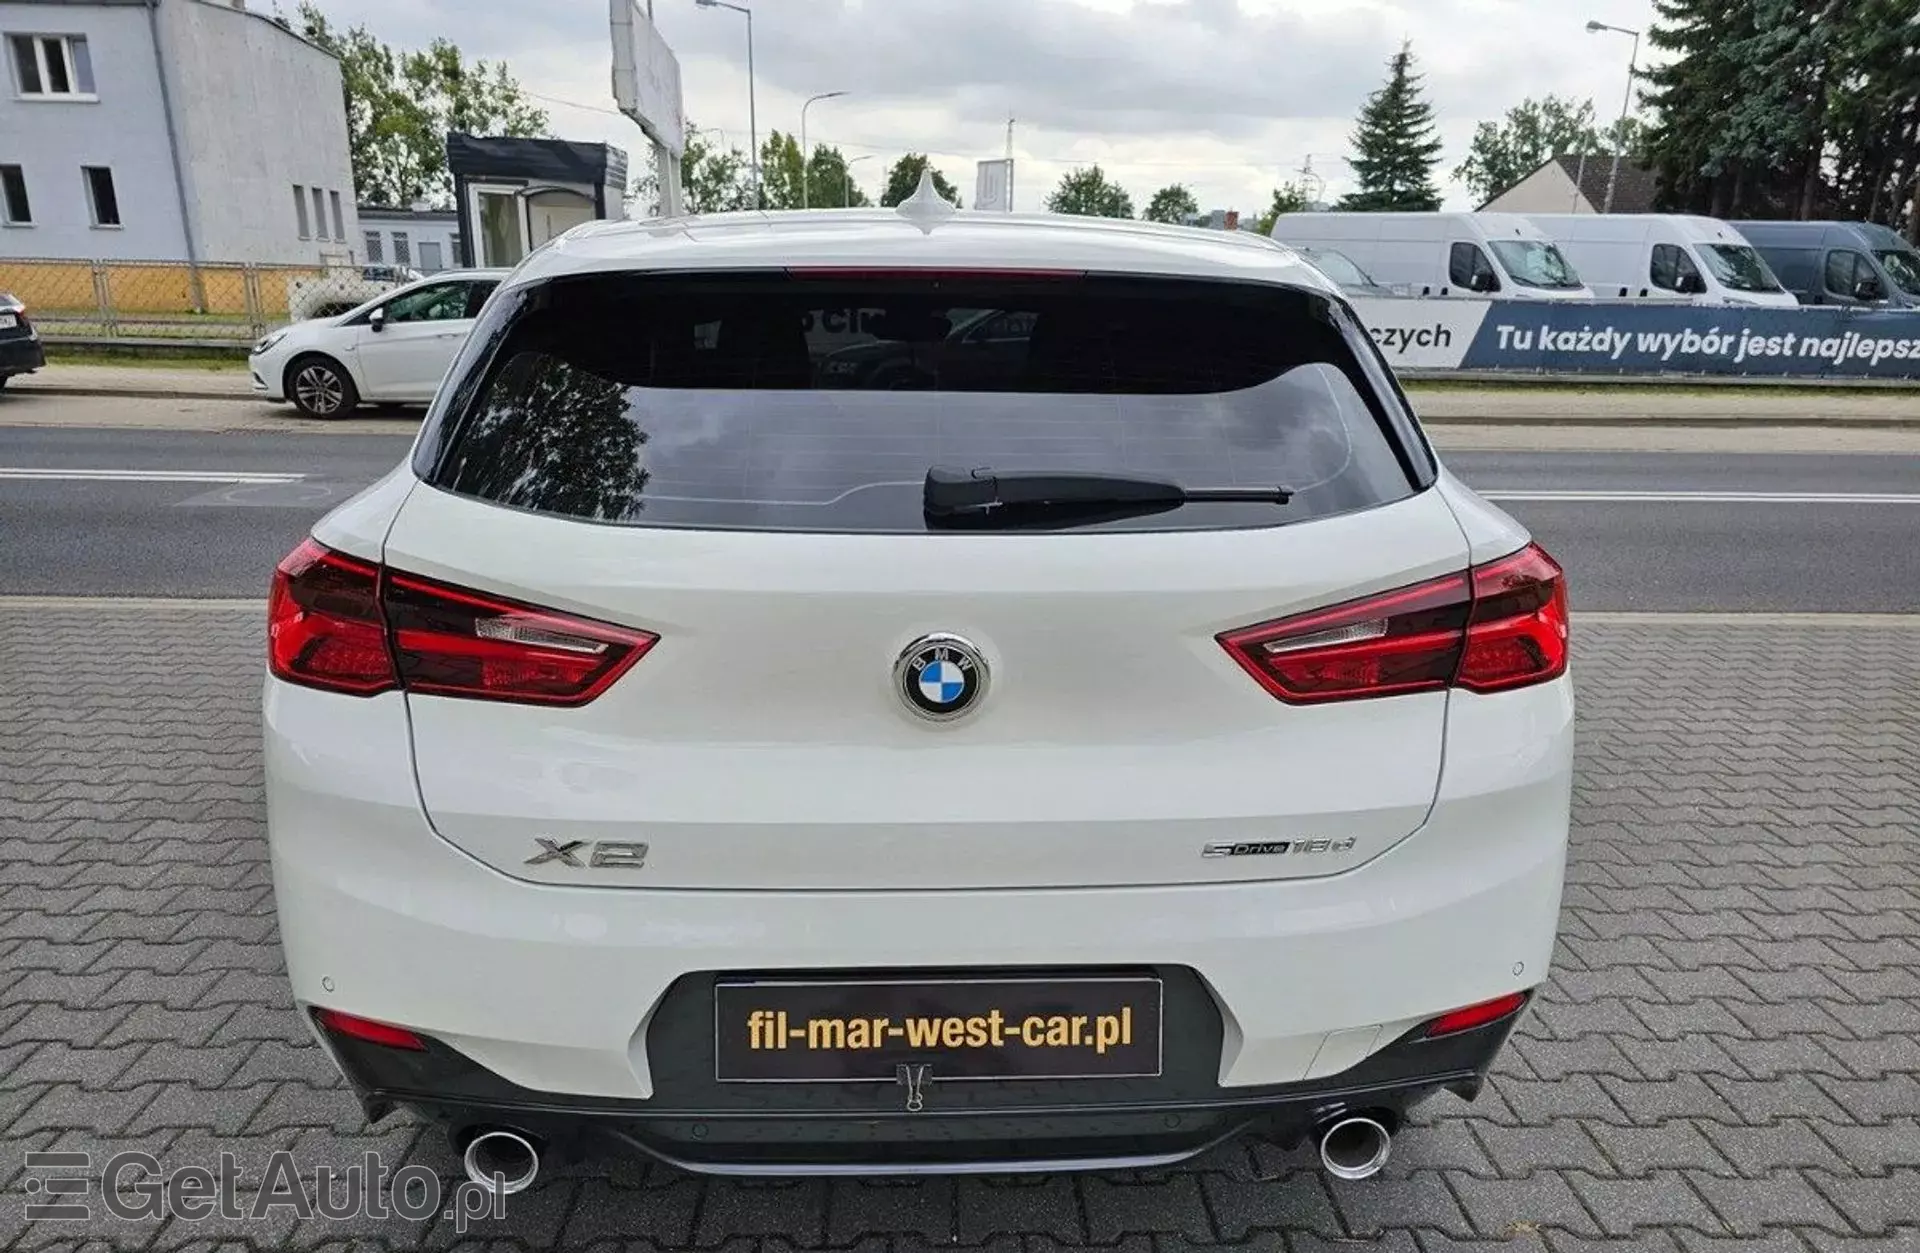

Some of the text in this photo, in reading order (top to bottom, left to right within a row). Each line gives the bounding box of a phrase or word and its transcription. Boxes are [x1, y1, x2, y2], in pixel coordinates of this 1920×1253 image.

[1497, 324, 1920, 366] Tu każdy wybór jest najlepsz
[912, 647, 972, 671] BMW
[523, 838, 649, 868] X2
[747, 1007, 1132, 1053] fil-mar-west-car.pl
